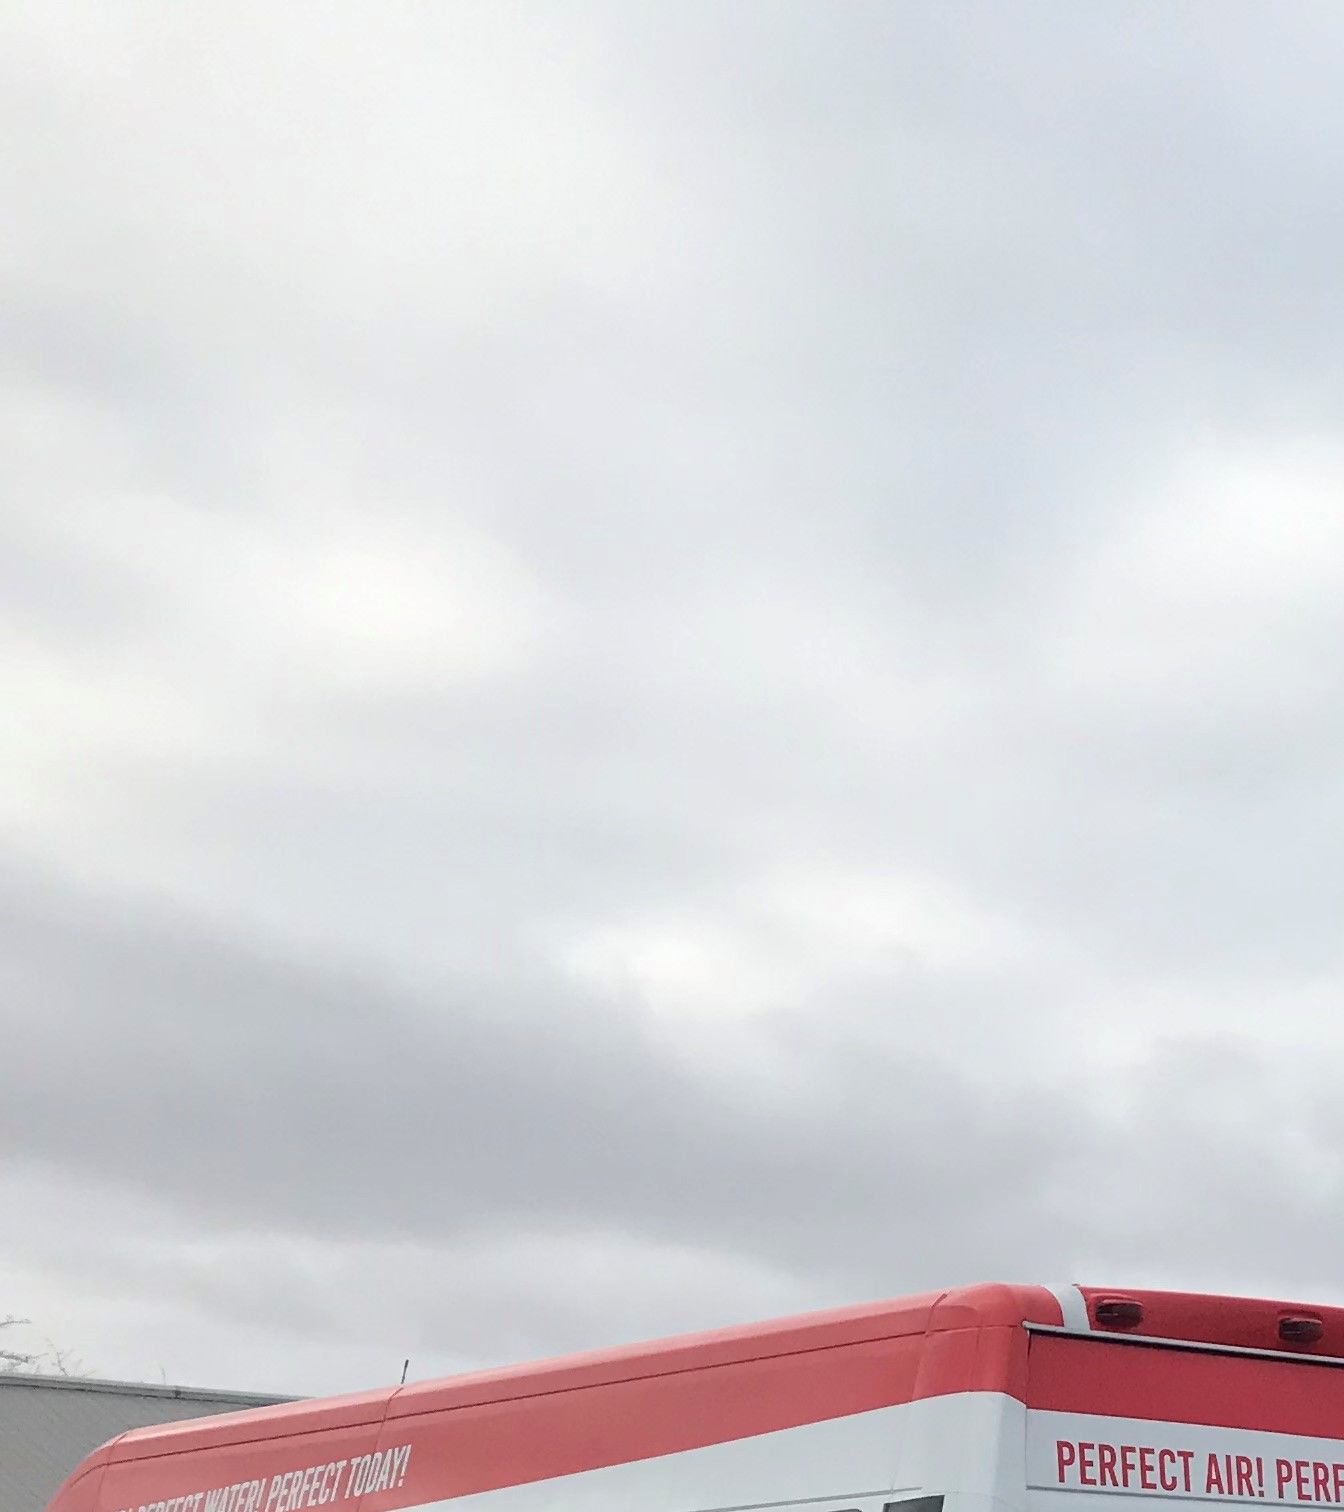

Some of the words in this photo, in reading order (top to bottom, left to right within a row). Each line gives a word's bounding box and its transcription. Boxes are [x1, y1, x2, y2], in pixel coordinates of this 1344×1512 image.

[344, 1445, 411, 1499] TODAY!
[1056, 1440, 1194, 1492] PERFECT
[1205, 1453, 1264, 1499] AIR!
